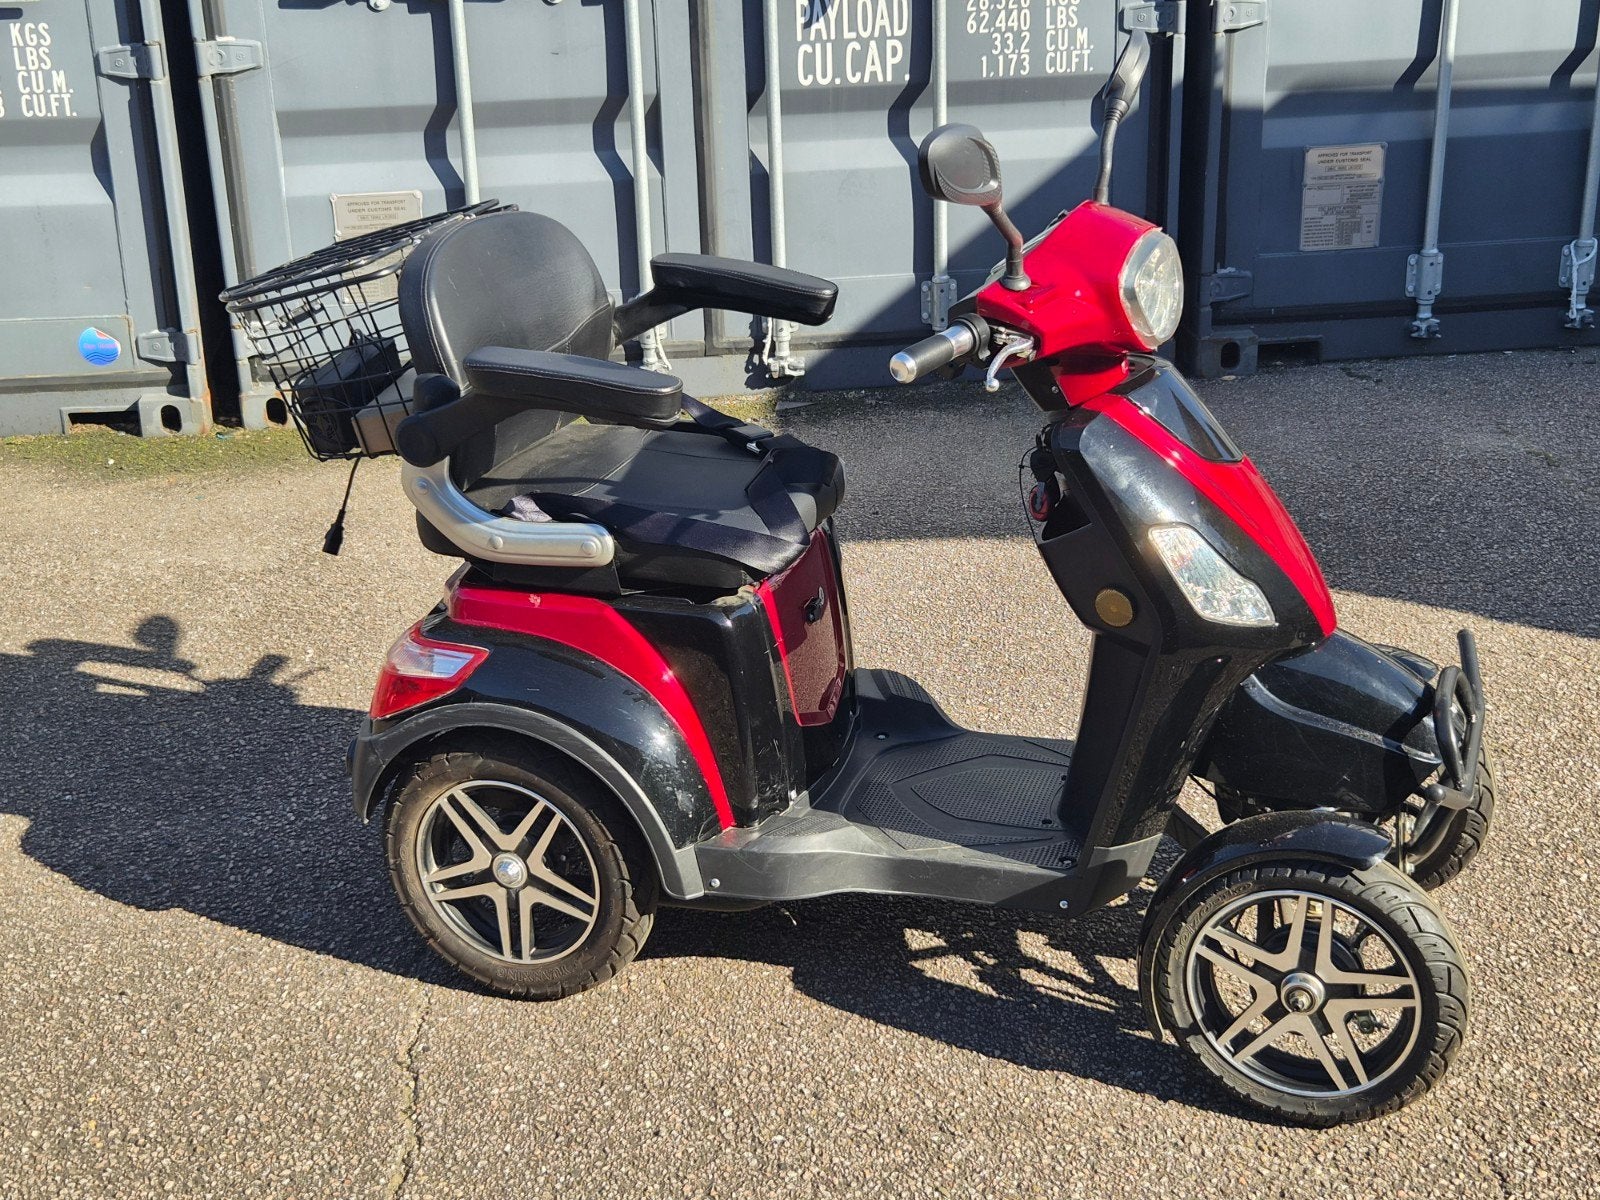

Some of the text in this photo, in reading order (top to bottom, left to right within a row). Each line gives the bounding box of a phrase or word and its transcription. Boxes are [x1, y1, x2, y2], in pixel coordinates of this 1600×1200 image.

[796, 0, 908, 41] PAYLOAD
[966, 8, 1030, 34] 62,440
[1046, 5, 1078, 29] LBS
[9, 22, 51, 47] KGS
[991, 27, 1094, 55] 33.2 CU.M.
[13, 46, 52, 71] LBS
[797, 39, 910, 87] CU.CAP.
[981, 49, 1094, 78] 1,173 CU.FT.
[17, 69, 74, 94] CU.M.
[21, 93, 77, 118] CU.FT.
